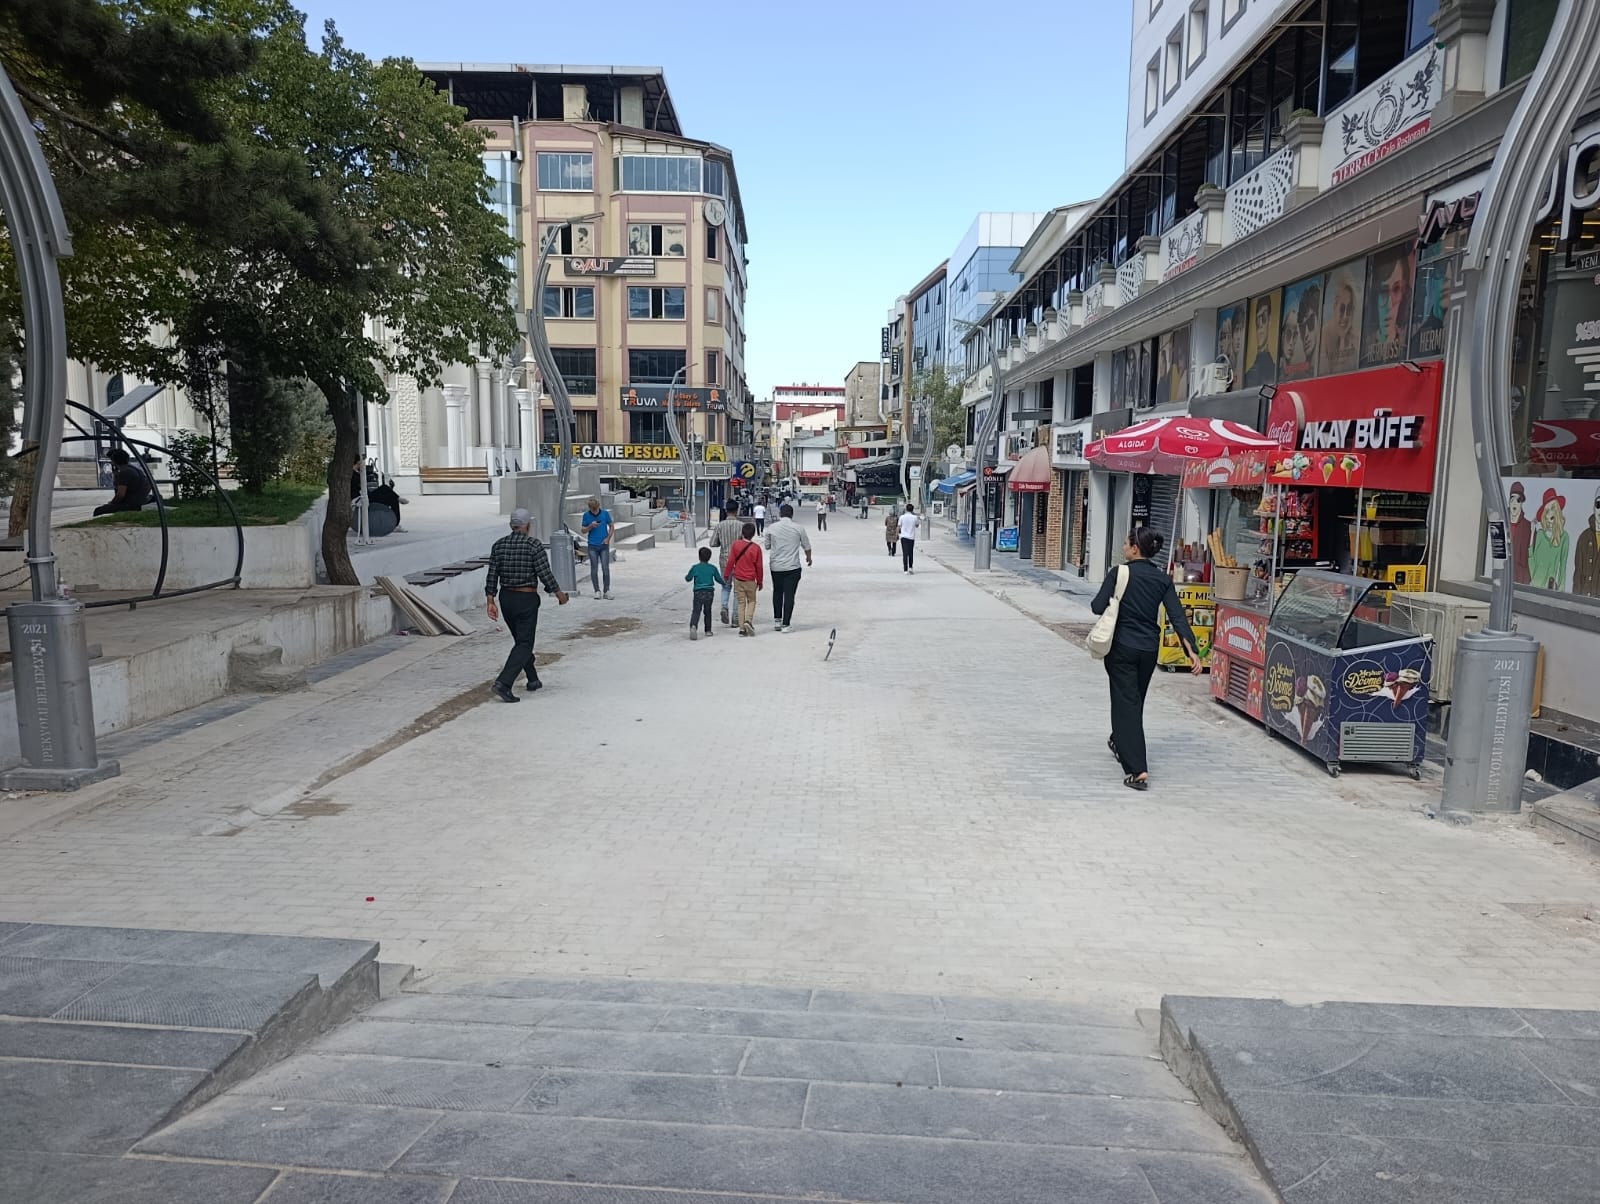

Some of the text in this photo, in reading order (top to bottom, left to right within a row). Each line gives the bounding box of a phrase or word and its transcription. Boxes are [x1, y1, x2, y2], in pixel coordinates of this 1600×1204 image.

[622, 397, 658, 407] TRUVA
[1301, 408, 1416, 449] AKAY BÜFE
[582, 445, 624, 458] GAME
[22, 623, 48, 635] 2021
[1494, 659, 1521, 672] 2021
